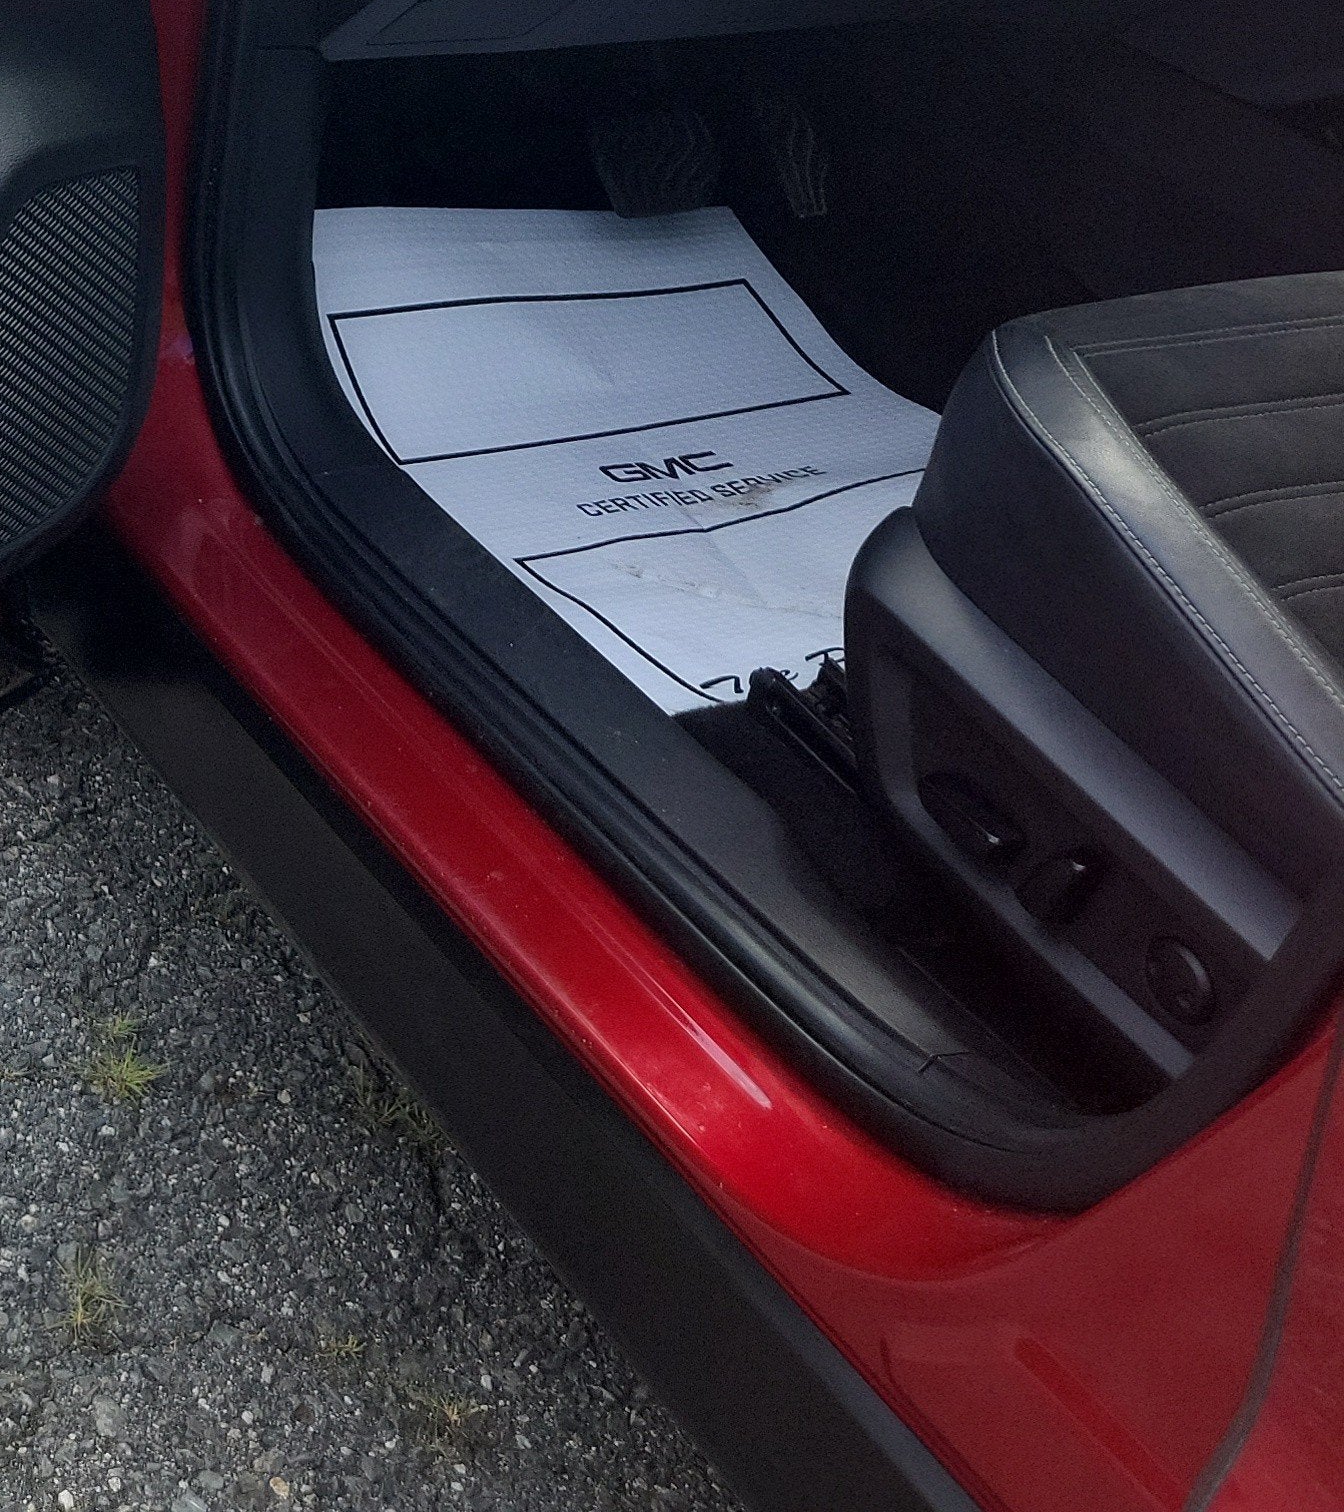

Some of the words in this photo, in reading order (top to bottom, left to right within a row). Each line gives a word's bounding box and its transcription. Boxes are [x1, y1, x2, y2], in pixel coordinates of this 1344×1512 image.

[598, 450, 734, 483] GMC
[711, 465, 827, 498] SERVICE
[576, 487, 714, 517] CERTIFIED
